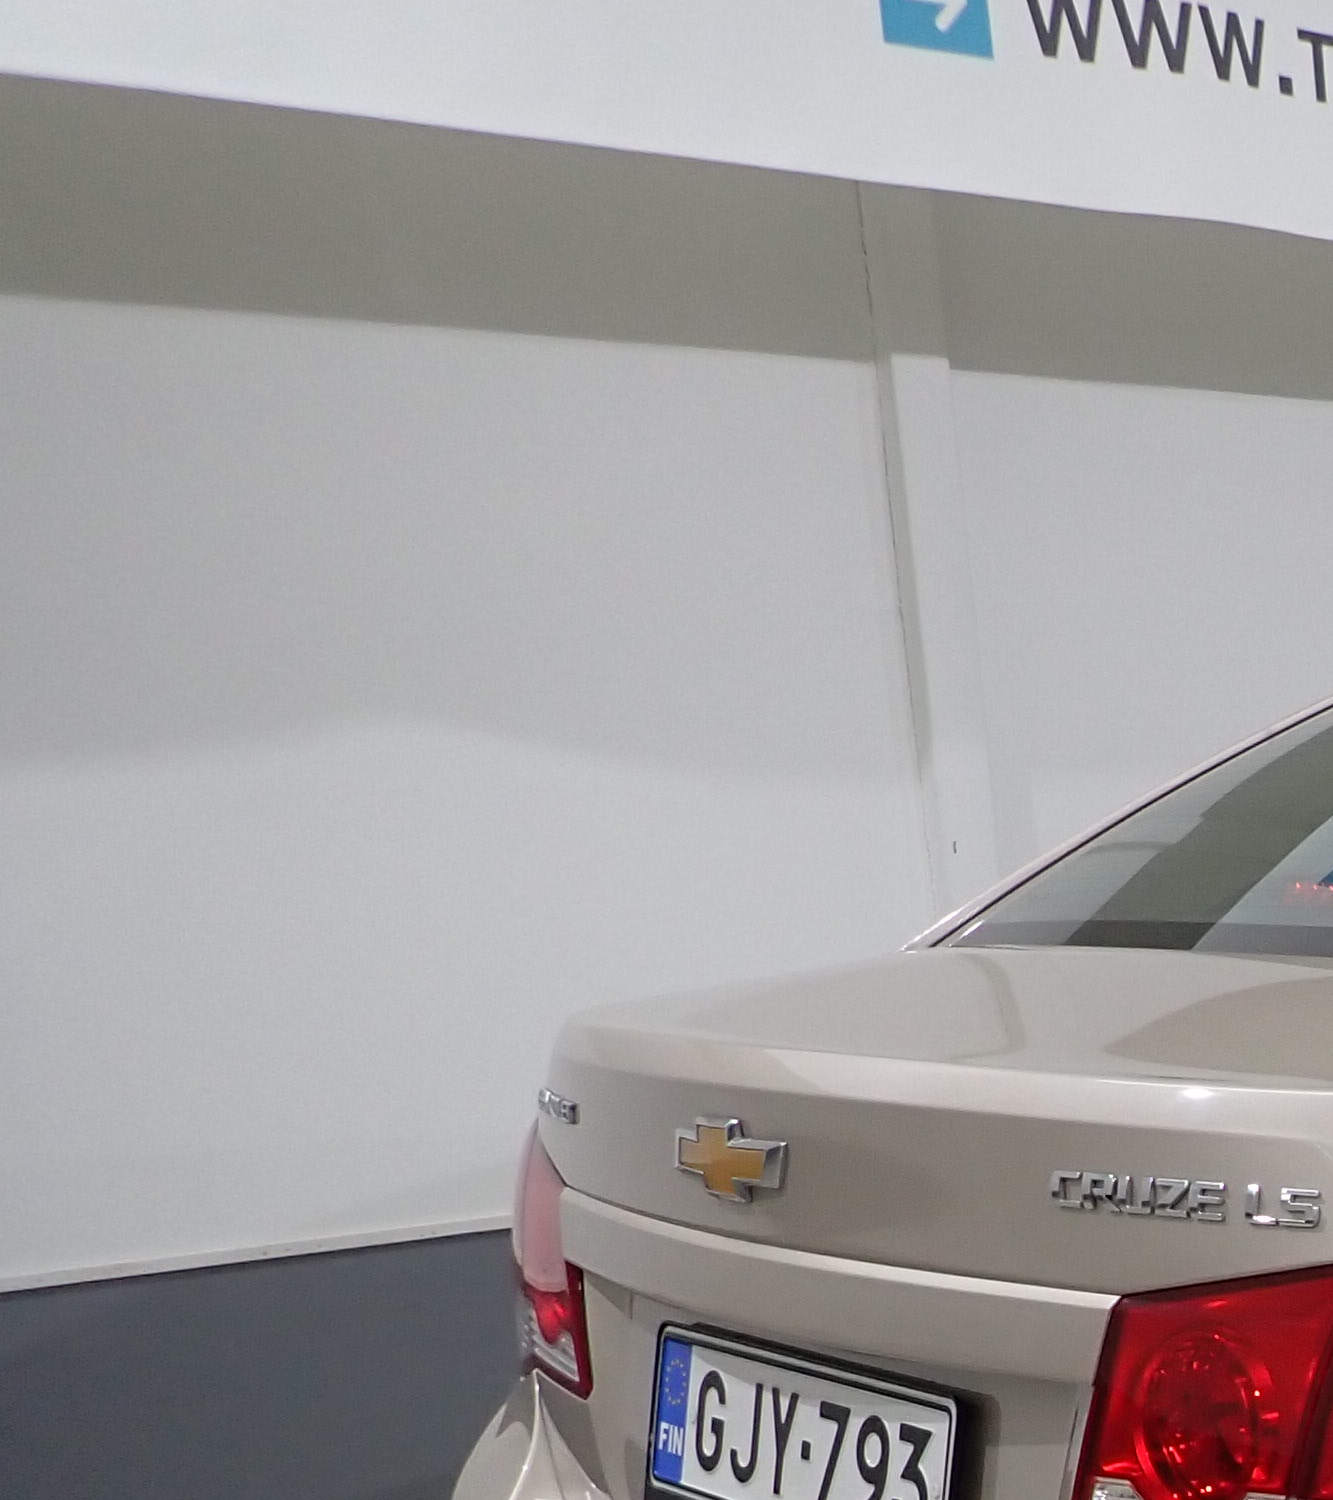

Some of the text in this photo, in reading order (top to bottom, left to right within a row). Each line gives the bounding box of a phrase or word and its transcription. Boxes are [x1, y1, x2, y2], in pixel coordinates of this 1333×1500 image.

[1051, 1170, 1321, 1228] CRUZE LS
[658, 1422, 684, 1457] FIN
